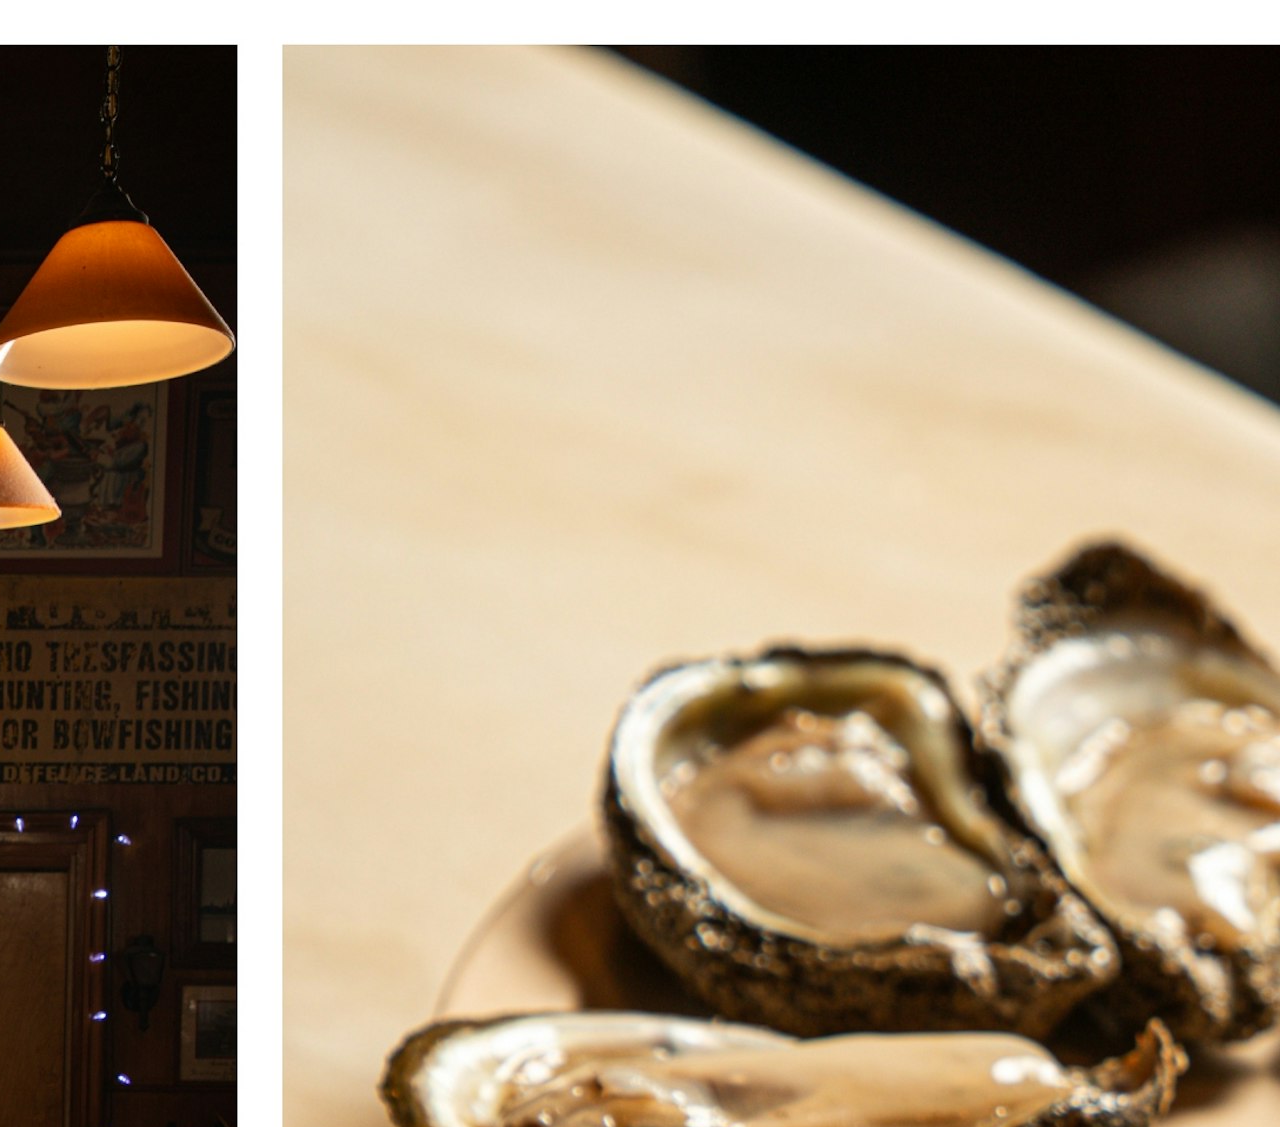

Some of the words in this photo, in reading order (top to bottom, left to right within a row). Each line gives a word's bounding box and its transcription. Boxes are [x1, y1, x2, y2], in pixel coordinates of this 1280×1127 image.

[135, 679, 237, 712] FISHIN
[1, 718, 39, 751] OR
[53, 718, 233, 751] BOWFISHING
[119, 764, 180, 783] LAND
